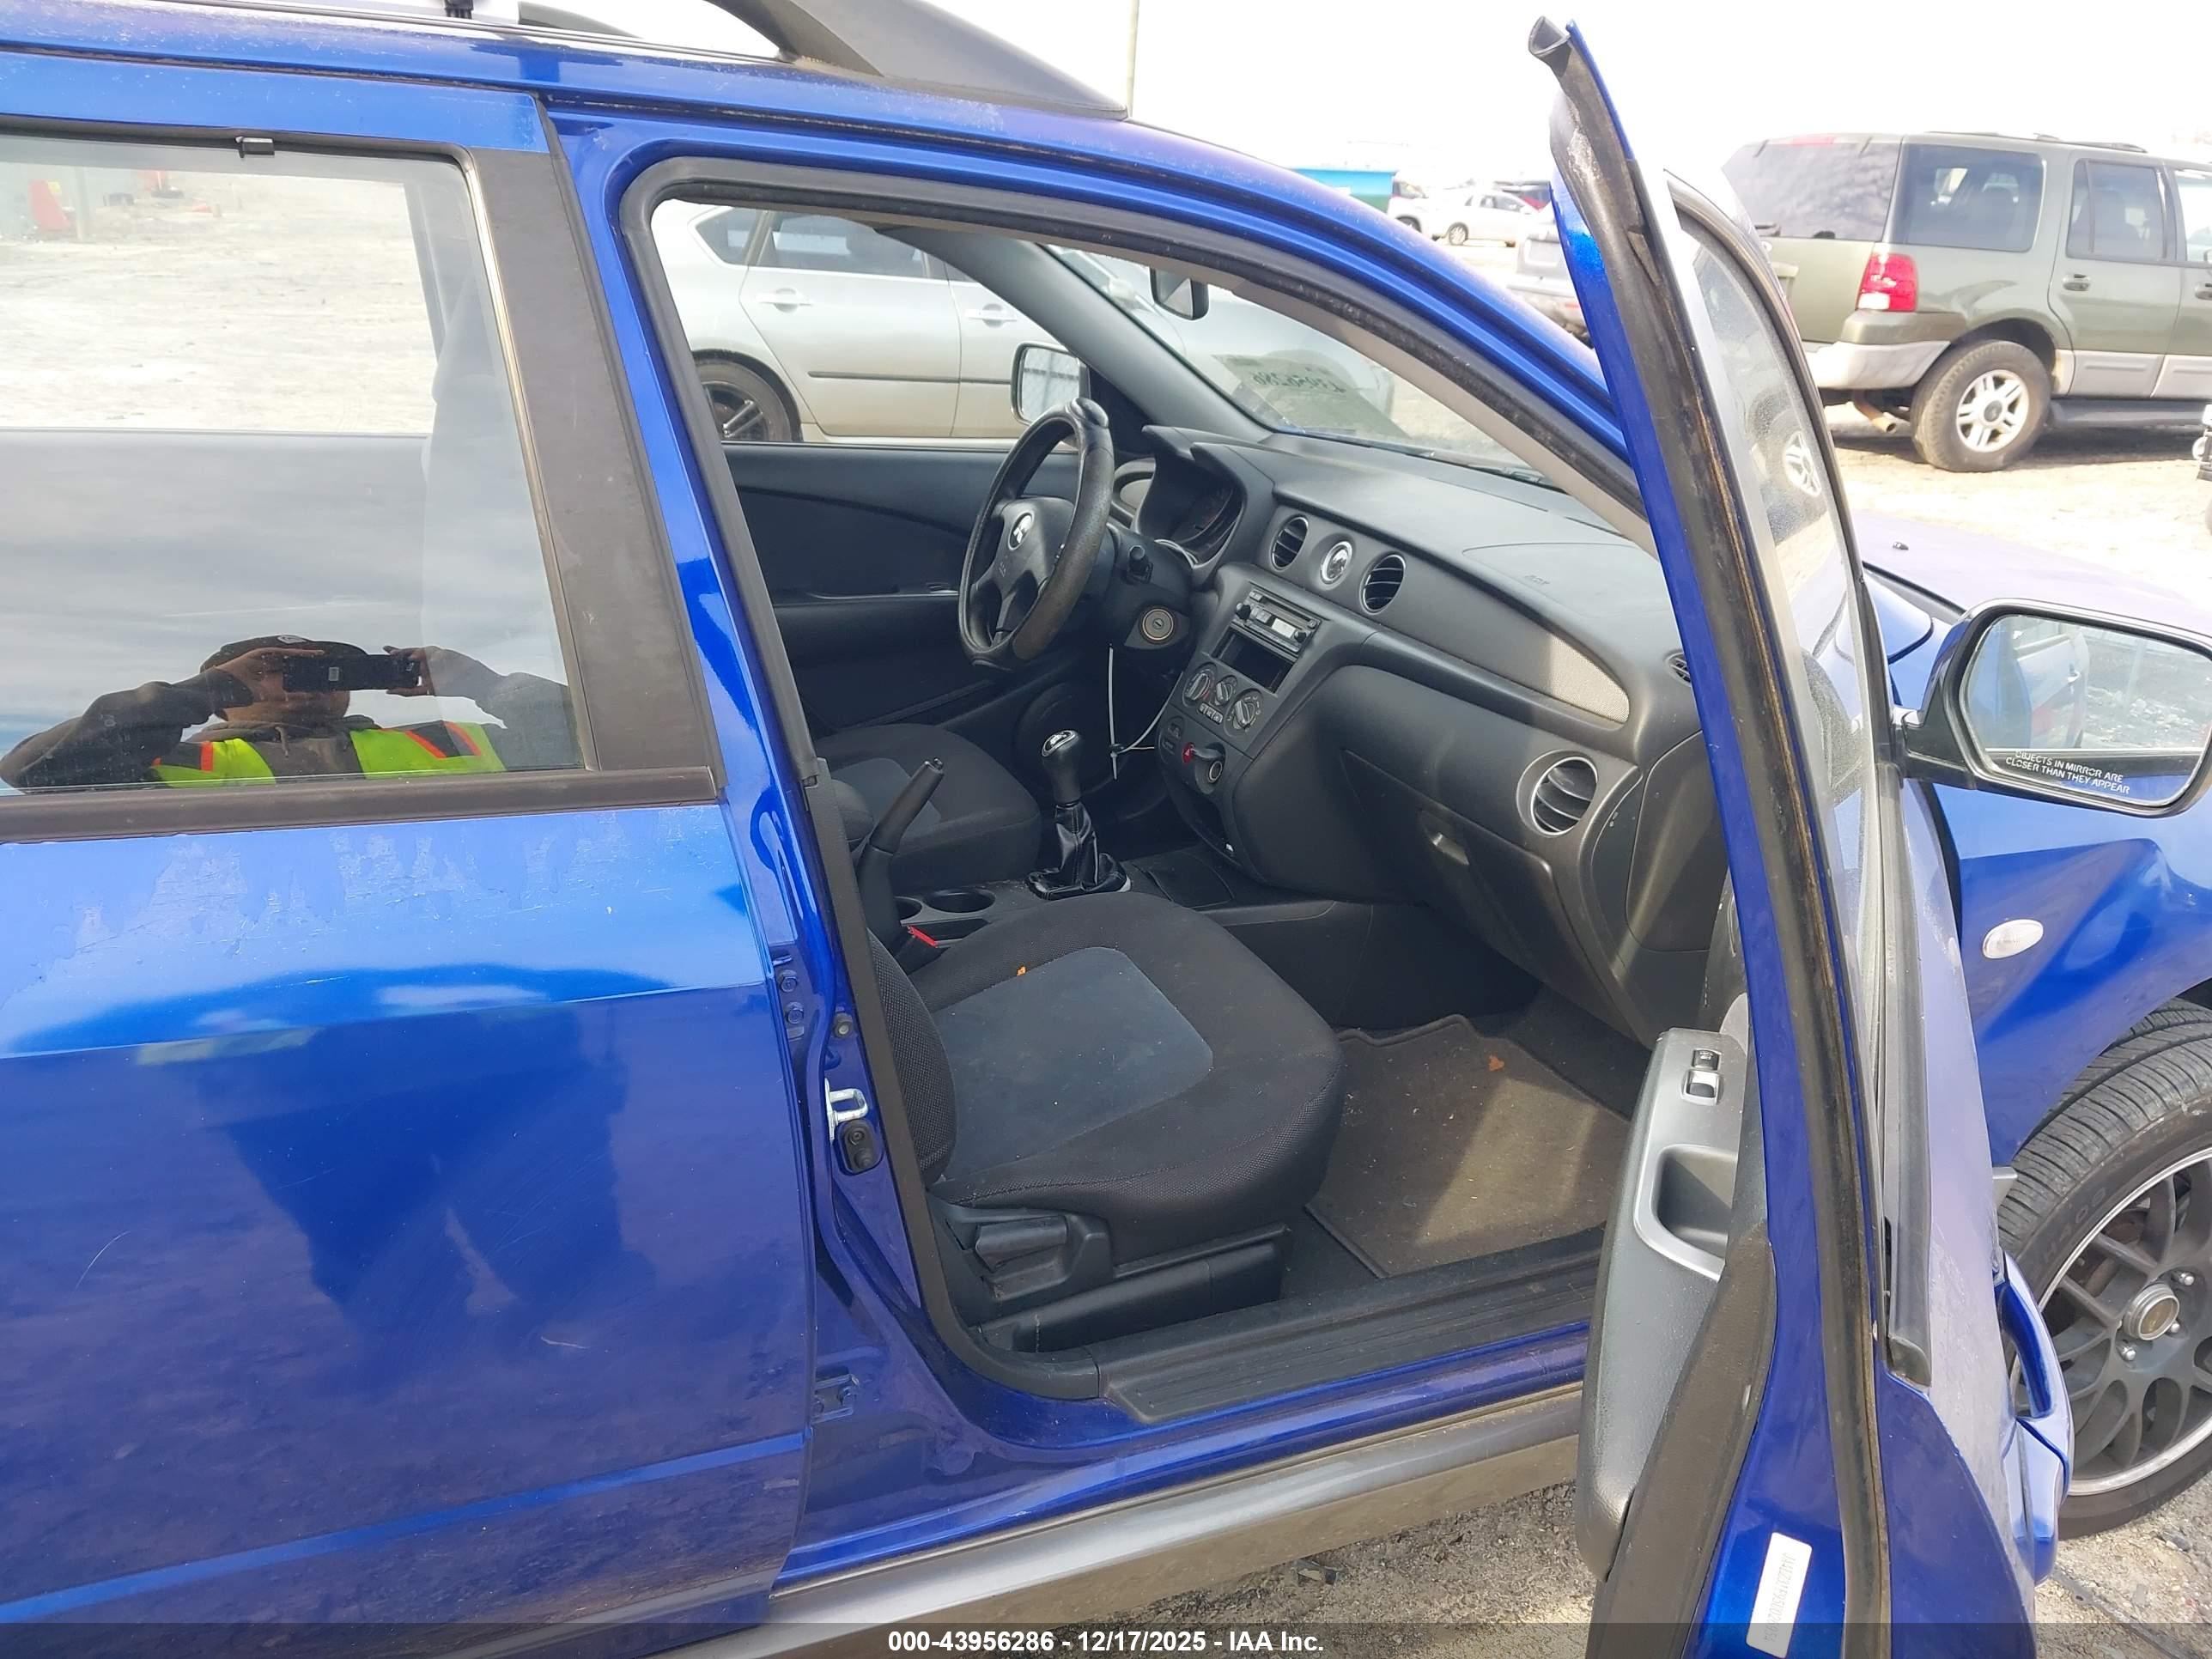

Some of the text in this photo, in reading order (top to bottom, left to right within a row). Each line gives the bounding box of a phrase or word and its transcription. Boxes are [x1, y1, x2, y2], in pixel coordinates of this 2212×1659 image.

[2005, 757, 2130, 794] CLOSER THAN THEY APPEAR
[2014, 750, 2124, 783] OBJECTS IN MIRROR ARE
